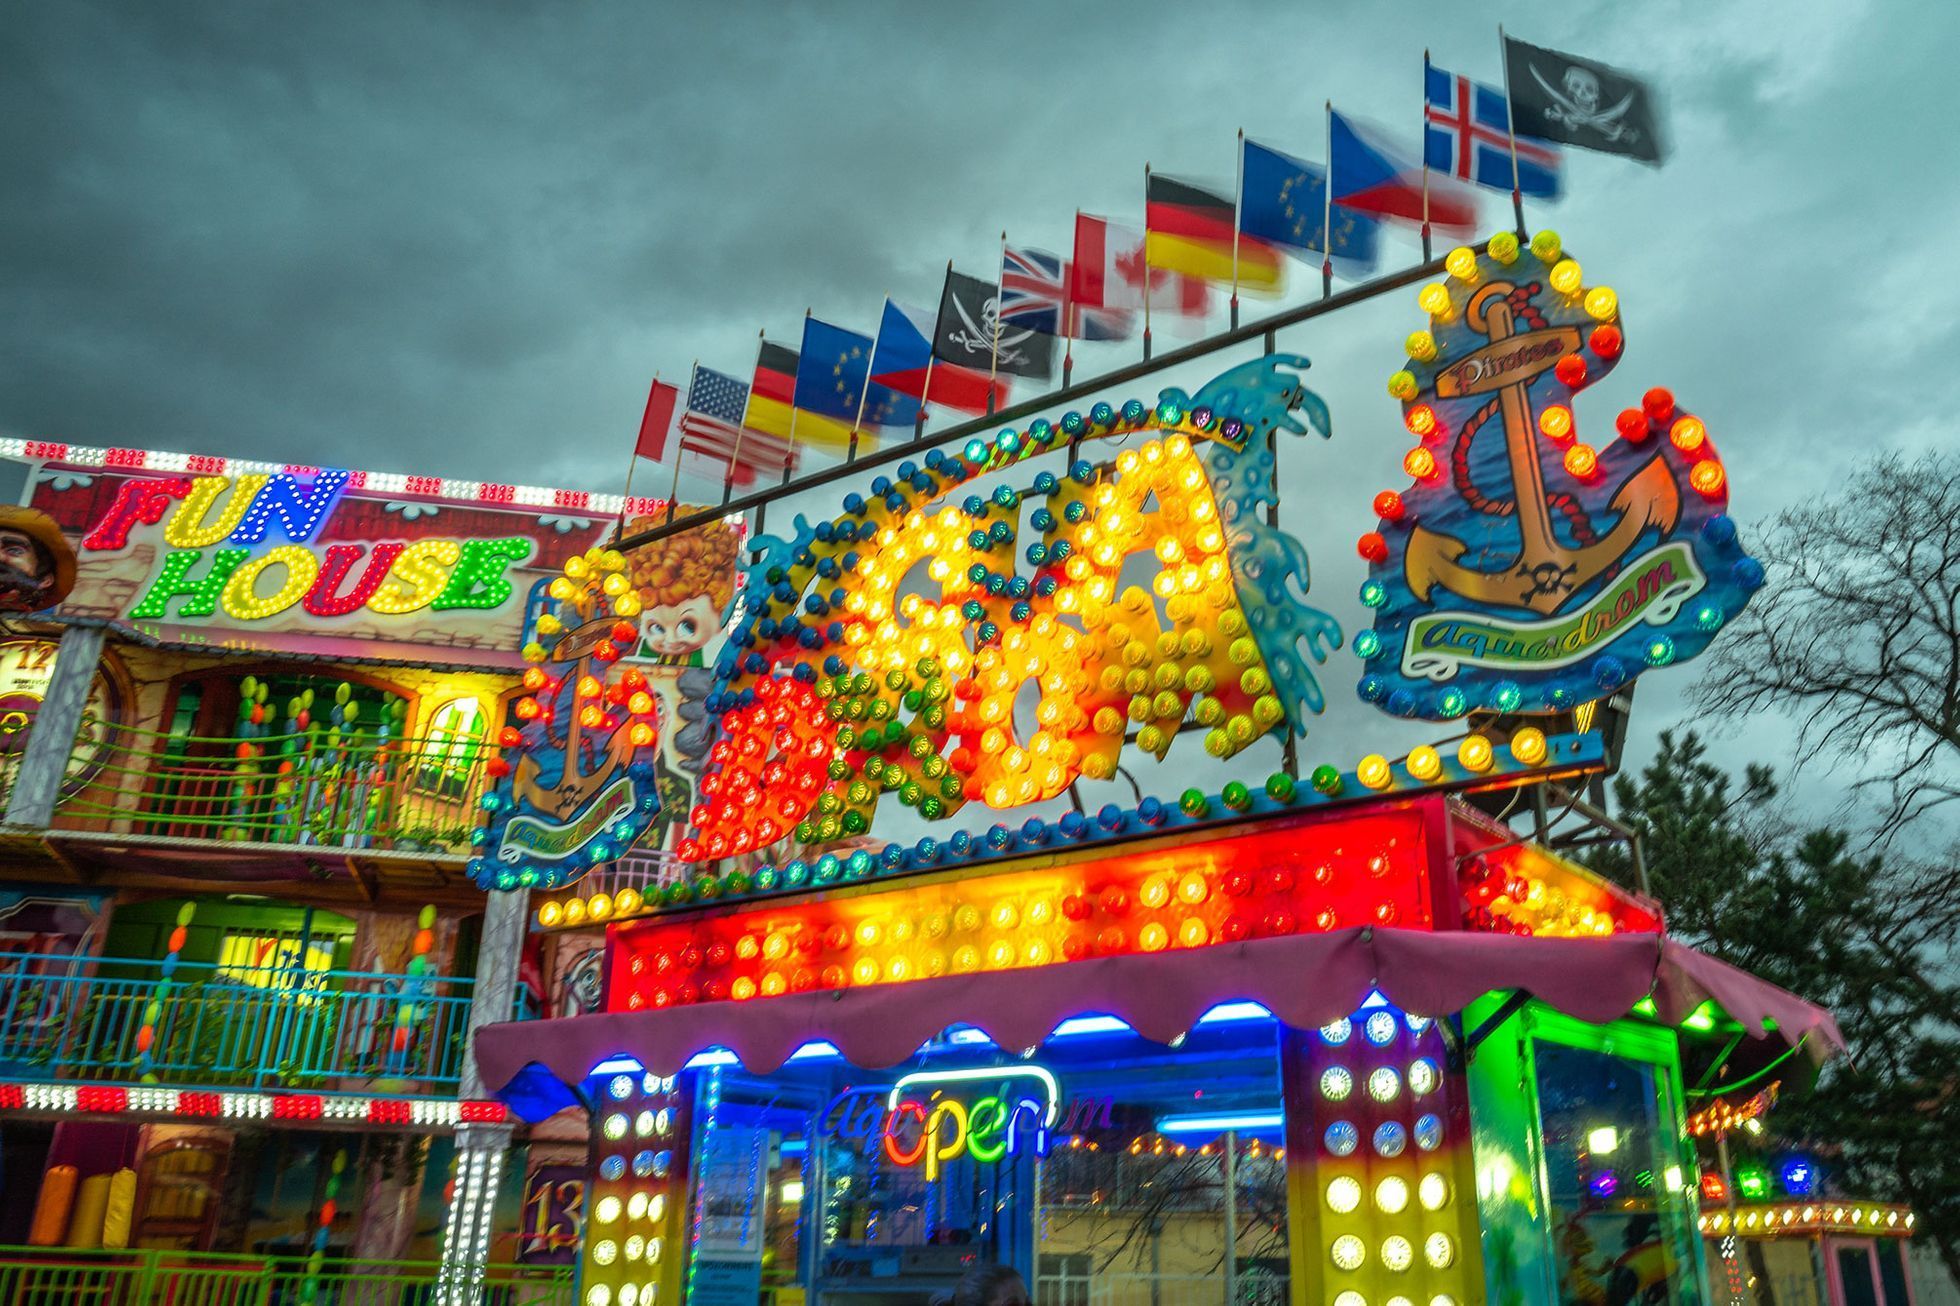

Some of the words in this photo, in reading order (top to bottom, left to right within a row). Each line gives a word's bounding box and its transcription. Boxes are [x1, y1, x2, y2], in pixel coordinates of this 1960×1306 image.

[1450, 338, 1564, 393] Pirates
[82, 469, 349, 549] FUN
[128, 536, 532, 620] HOUSE
[15, 643, 54, 670] 12
[884, 1092, 1050, 1182] open
[523, 1180, 584, 1255] 13
